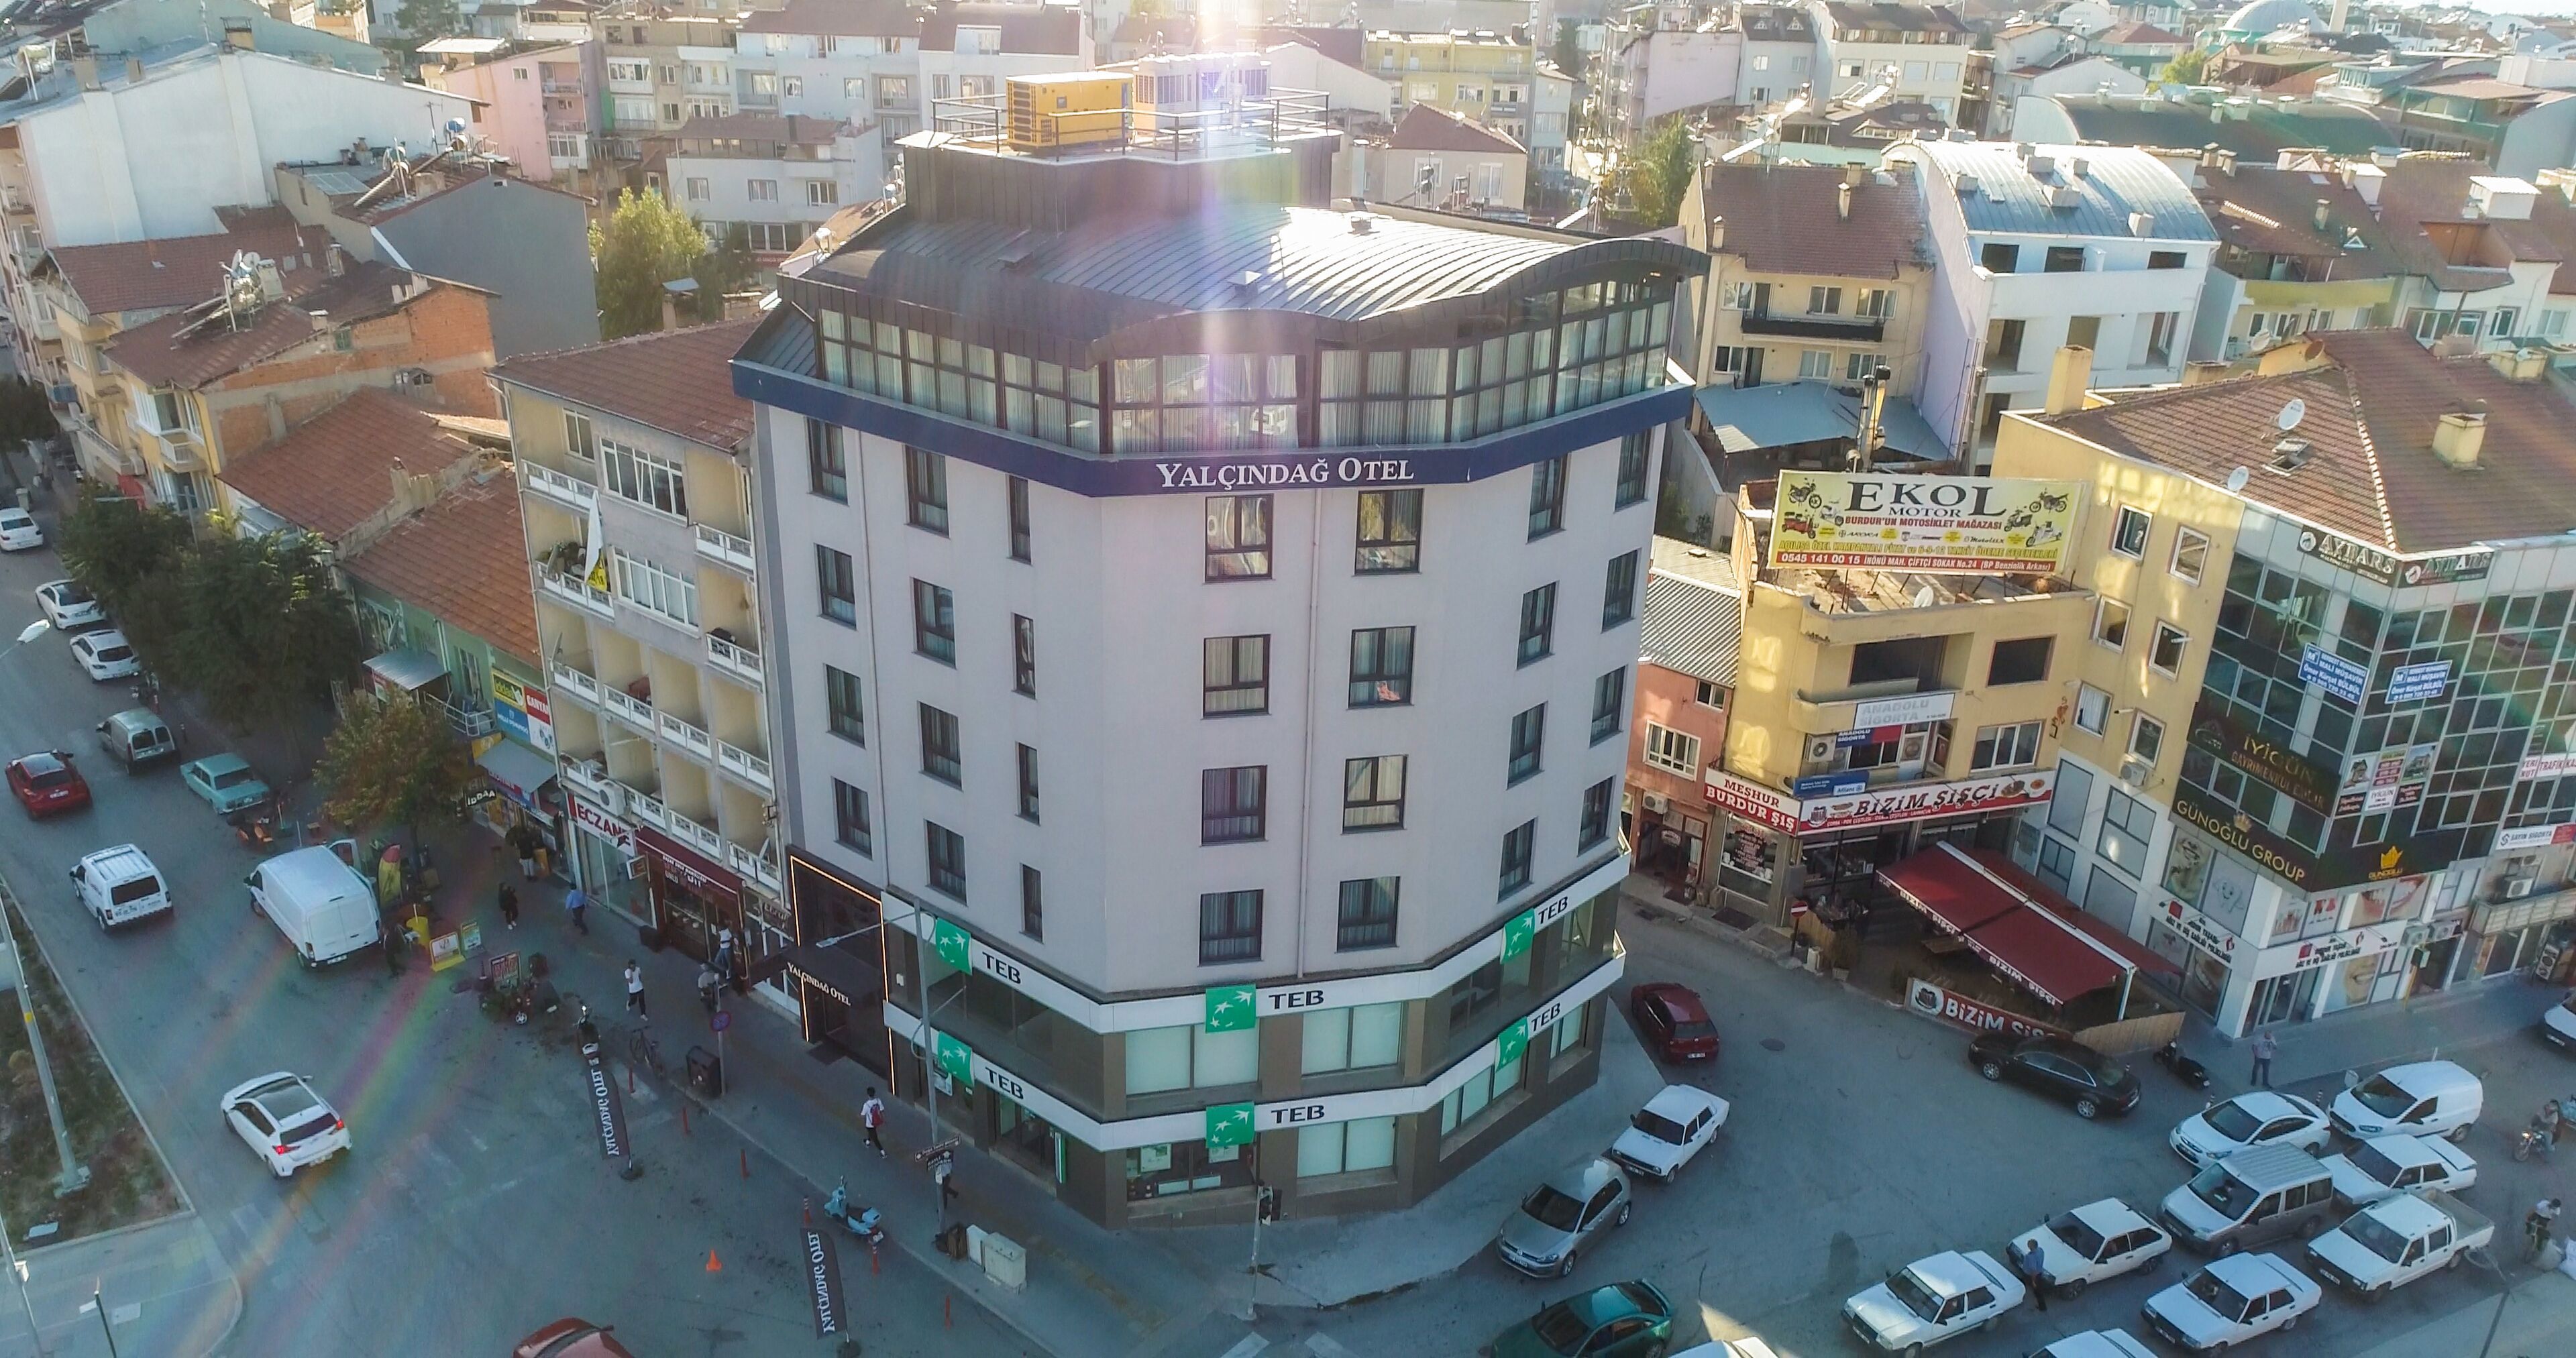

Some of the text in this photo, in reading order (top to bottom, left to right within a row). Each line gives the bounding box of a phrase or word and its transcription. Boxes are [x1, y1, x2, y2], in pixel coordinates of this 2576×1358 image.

[1156, 457, 1415, 490] YALÇINDAĞ OTEL
[1844, 481, 2007, 516] EKOL
[1889, 507, 1961, 518] MOTOR
[1845, 515, 2002, 530] BURDUR'UN MOTOSİKLET MAĞAZASI
[1781, 553, 1807, 562] 0545
[1811, 554, 1829, 563] 141
[1831, 554, 1845, 564] 00
[1848, 555, 1860, 564] 15
[1864, 554, 1886, 565] İNÖNÜ
[1887, 556, 1906, 566] MAH.
[1907, 556, 1931, 567] ÇİFTÇİ
[1932, 559, 1957, 568] SOKAK
[1956, 560, 1978, 569] No.24
[2318, 534, 2396, 575] AYBARS
[1862, 698, 1929, 715] ANADOLU
[1837, 728, 1871, 736] ANADOLU
[1706, 785, 1795, 832] BURDUR ŞİŞ
[1724, 779, 1780, 807] MEŞHUR
[1854, 783, 1999, 816] BİZİM ŞİŞÇİ
[577, 803, 631, 847] ECZANE
[2177, 799, 2305, 882] GÜNOĞLU GROUP
[1538, 896, 1568, 925] TEB
[1899, 889, 1927, 914] BİZİM
[982, 951, 1021, 984] TEB
[1988, 955, 2023, 983] BİZİM
[787, 961, 851, 1007] YALÇINDAĞ OTEL
[1269, 990, 1324, 1010] TEB
[1945, 997, 2005, 1031] BİZİM
[1531, 1002, 1561, 1033] TEB
[985, 1066, 1024, 1100] TEB
[1271, 1105, 1325, 1124] TEB
